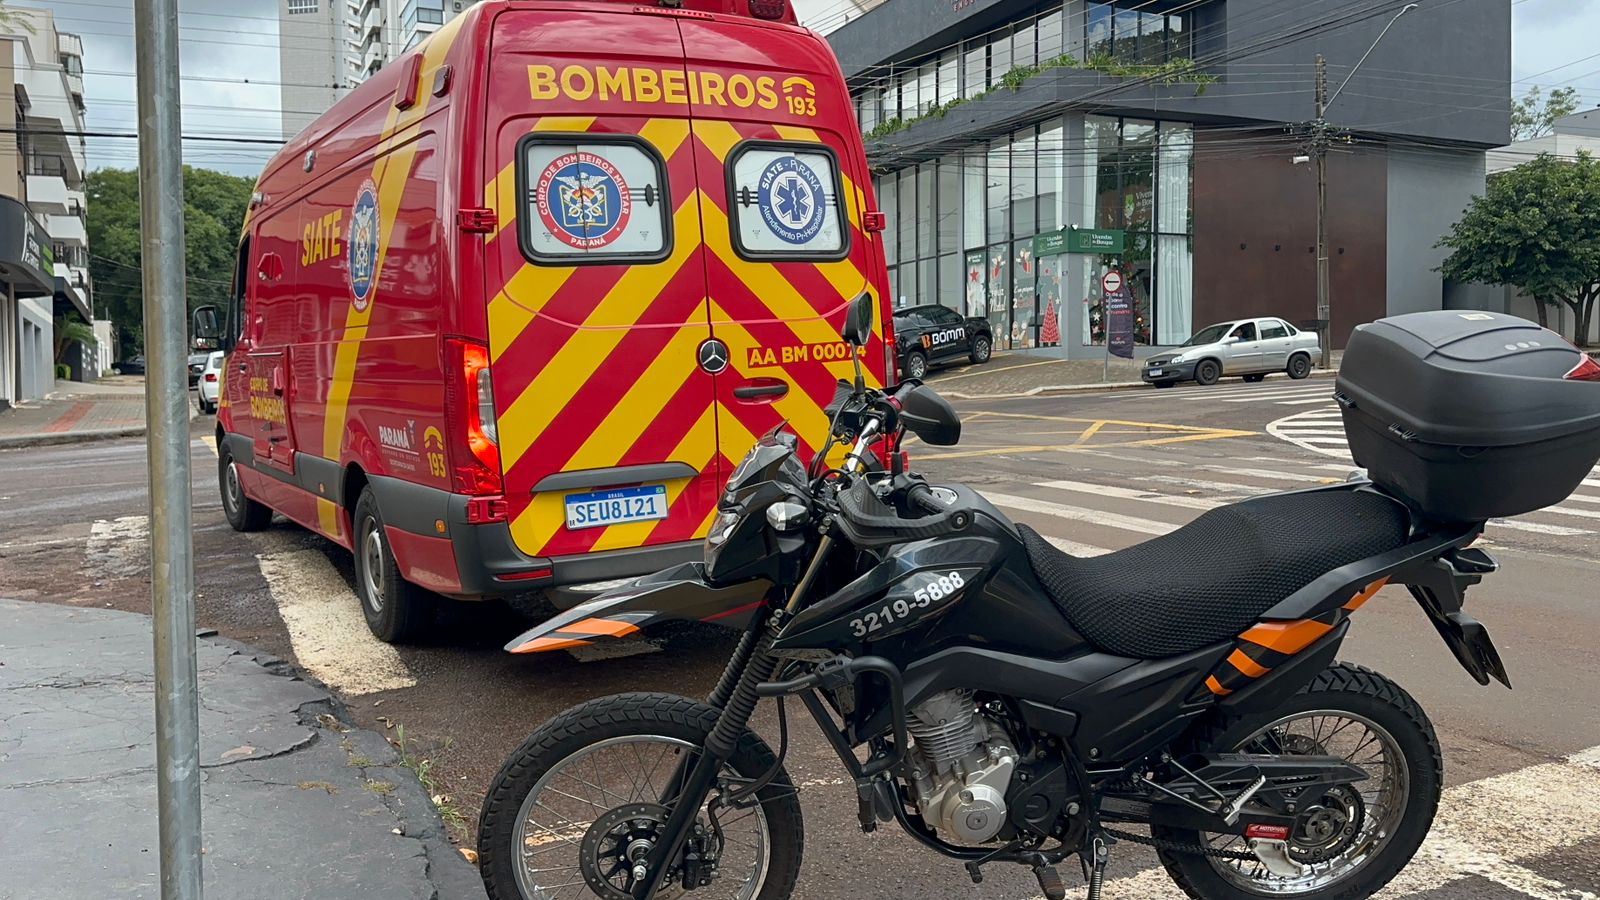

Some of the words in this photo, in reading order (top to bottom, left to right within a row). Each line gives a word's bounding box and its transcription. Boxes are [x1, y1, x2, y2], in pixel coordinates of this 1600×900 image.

[527, 64, 778, 110] BOMBEIROS
[785, 96, 817, 116] 193
[538, 181, 549, 216] CORPO
[545, 165, 557, 179] DE
[556, 154, 615, 175] BOMBEIROS
[614, 174, 630, 215] MILITAR
[762, 162, 784, 190] SIATE
[762, 205, 796, 240] Atendimento
[302, 208, 343, 267] SIATE
[749, 348, 777, 366] AA
[781, 345, 808, 363] BM
[379, 426, 410, 449] PARANÁ
[427, 452, 446, 478] 193
[575, 497, 657, 523] SEU8I21
[849, 571, 965, 637] 3219-5888
